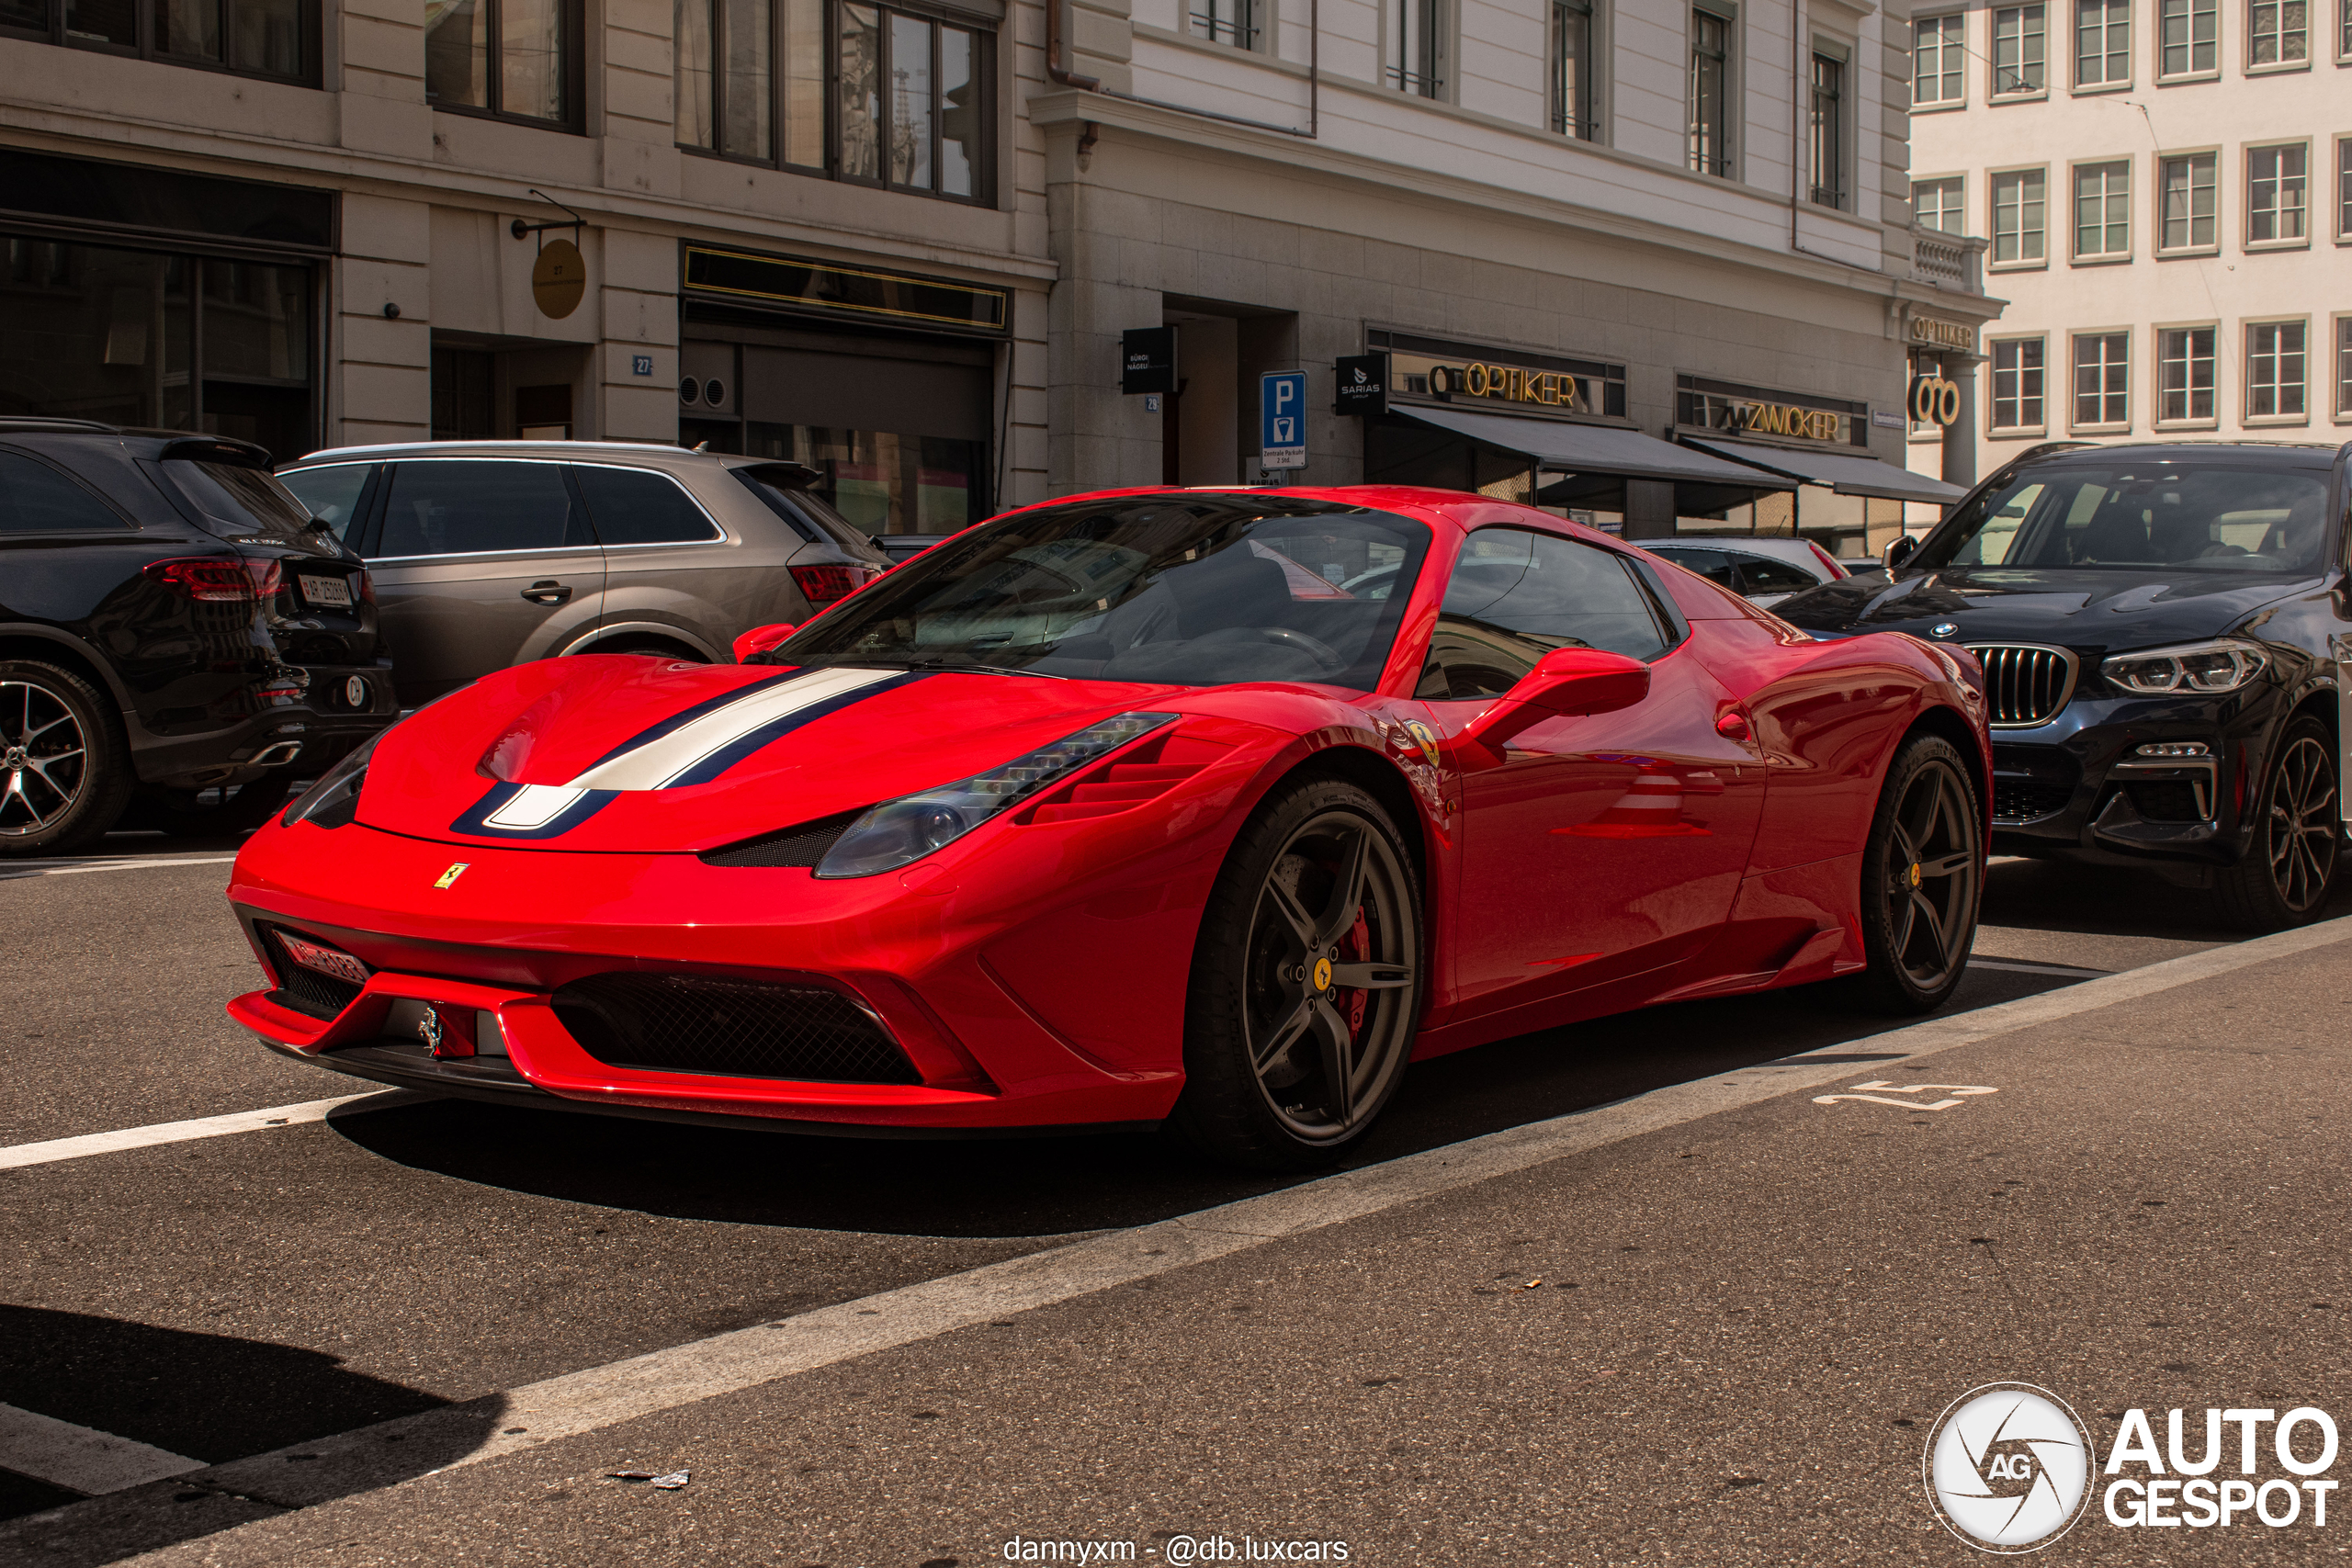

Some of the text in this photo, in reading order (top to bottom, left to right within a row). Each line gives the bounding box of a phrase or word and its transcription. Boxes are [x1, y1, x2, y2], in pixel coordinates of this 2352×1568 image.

[1913, 316, 1973, 349] OPTIKER
[637, 358, 650, 373] 27
[1130, 354, 1148, 362] BÜRGI
[1341, 384, 1380, 394] SARIAS
[1464, 363, 1575, 407] OPTIKER
[1148, 398, 1158, 411] 29
[1275, 380, 1294, 415] P
[1743, 401, 1838, 441] ZWICKER
[351, 680, 360, 702] CH
